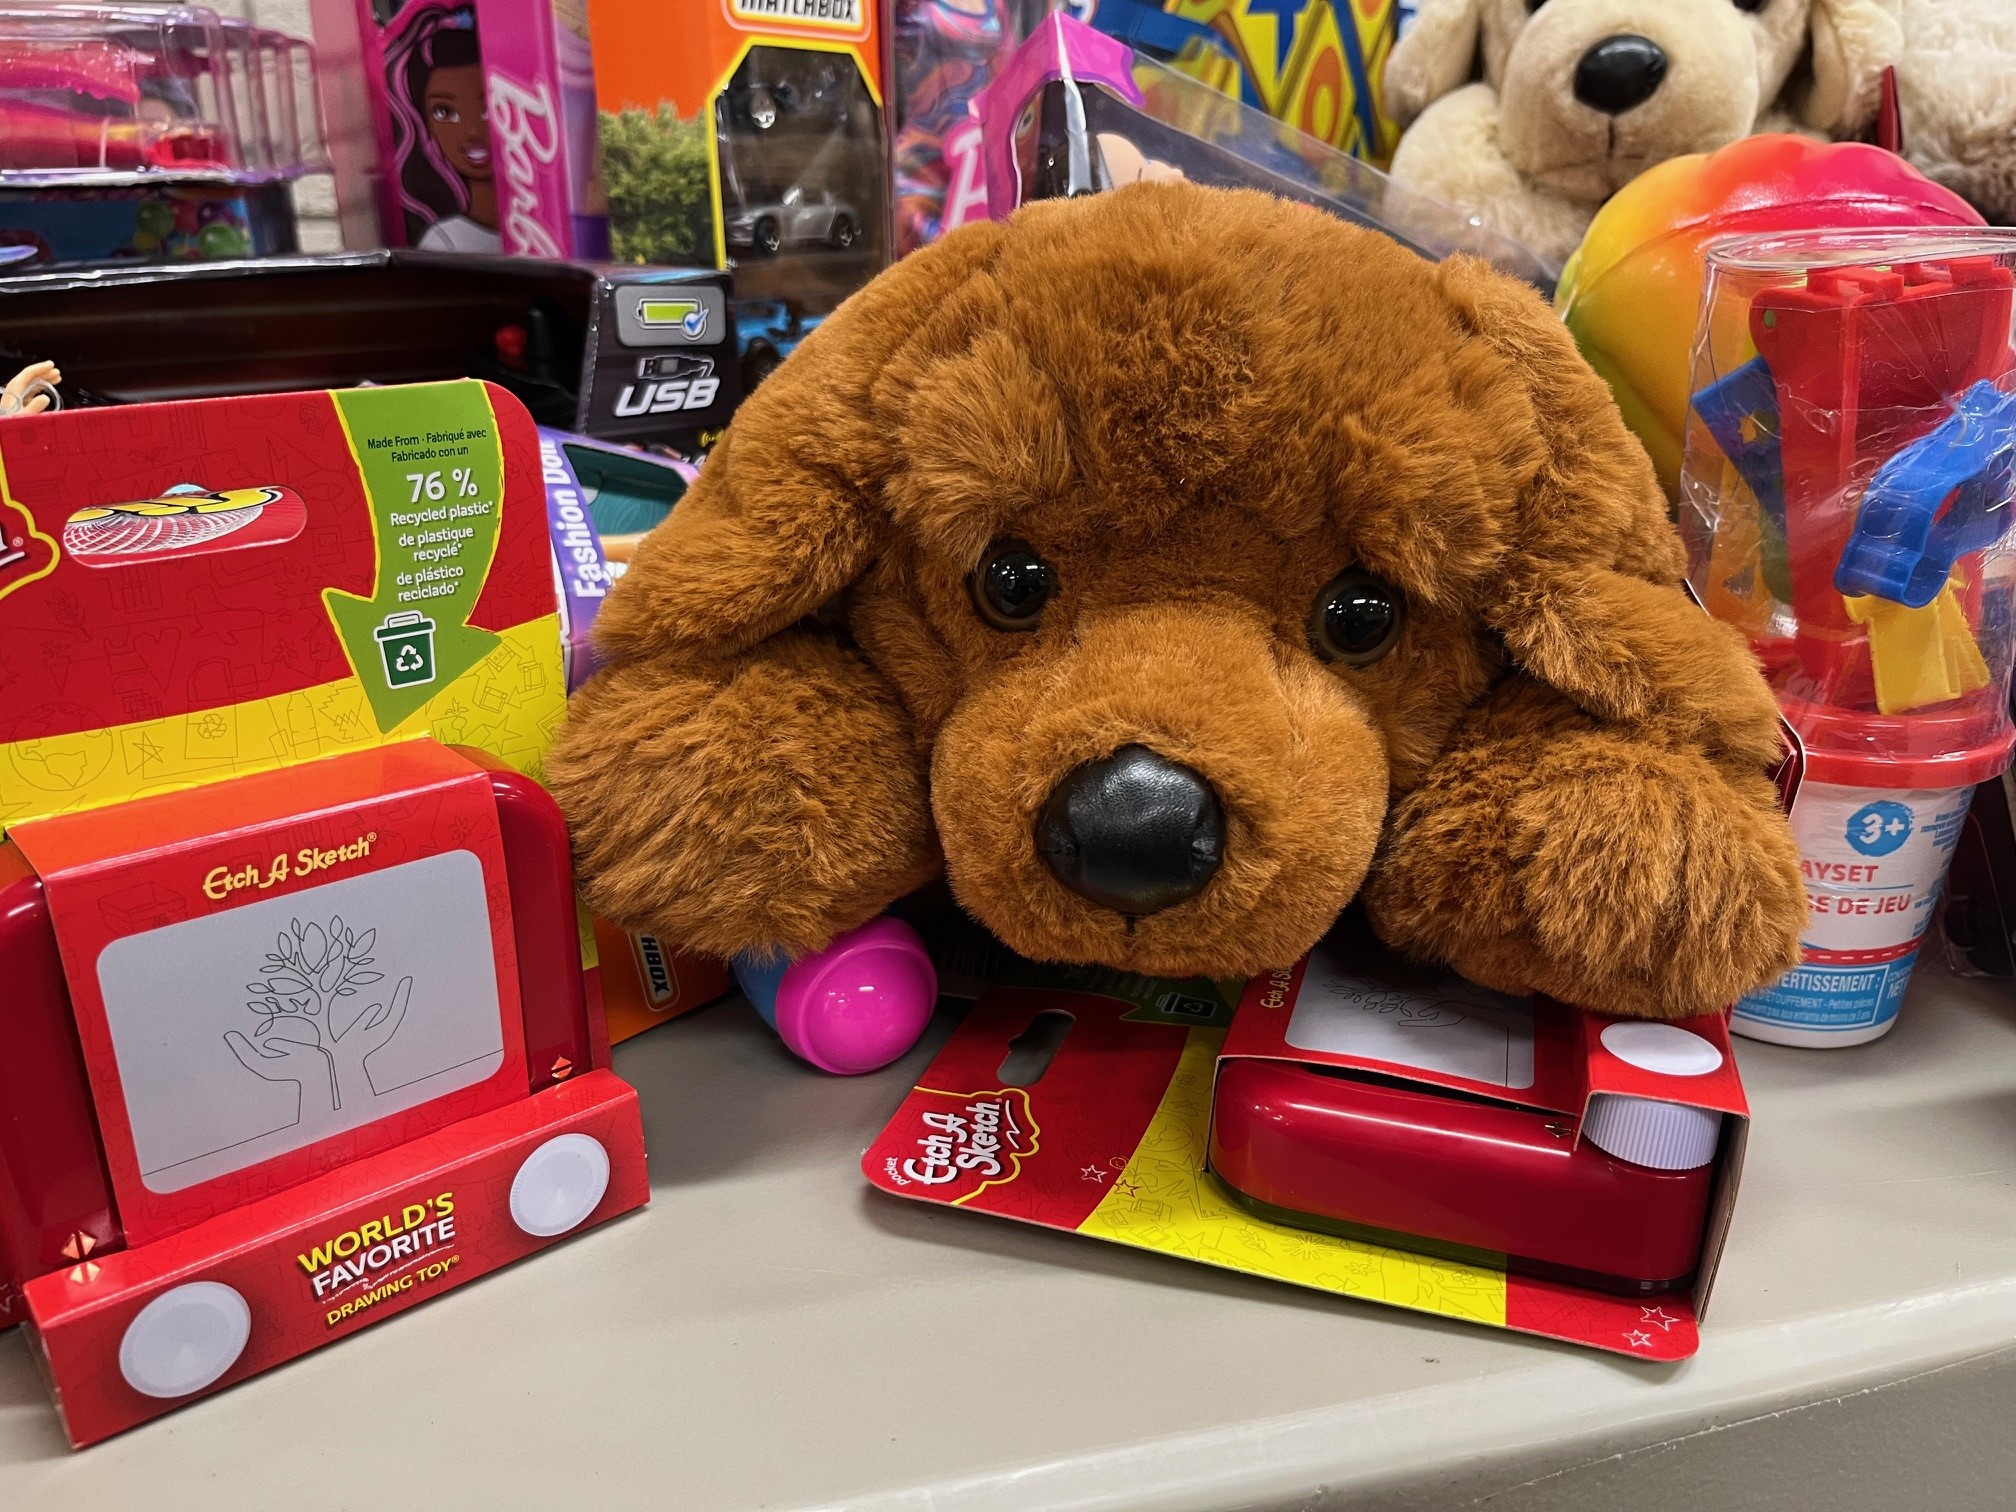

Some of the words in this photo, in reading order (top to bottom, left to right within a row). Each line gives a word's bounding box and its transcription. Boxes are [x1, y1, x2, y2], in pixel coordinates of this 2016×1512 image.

[615, 377, 720, 417] USB
[367, 437, 393, 449] Made
[395, 435, 419, 447] From
[426, 428, 465, 444] Fabriqué
[466, 428, 487, 439] avec
[391, 447, 437, 462] Fabricado
[440, 446, 455, 457] con
[457, 446, 469, 455] un
[406, 471, 446, 503] 76
[452, 468, 478, 497] %
[390, 506, 447, 526] Recycled
[398, 533, 415, 546] de
[417, 527, 474, 547] plastique
[554, 489, 606, 597] Fashion
[396, 572, 413, 585] de
[415, 565, 464, 586] plástico
[1859, 813, 1905, 844] 3+
[203, 865, 259, 899] Etch
[259, 853, 290, 888] A
[1837, 896, 1868, 914] DE
[1873, 894, 1912, 914] JEU
[1779, 972, 1876, 993] ERTISSEMENT
[922, 1112, 968, 1143] A
[884, 1156, 912, 1186] pocket
[903, 1134, 957, 1185] Etch
[298, 1192, 455, 1273] WORLD'S
[312, 1217, 456, 1296] FAVORITE
[326, 1274, 414, 1325] DRAWING
